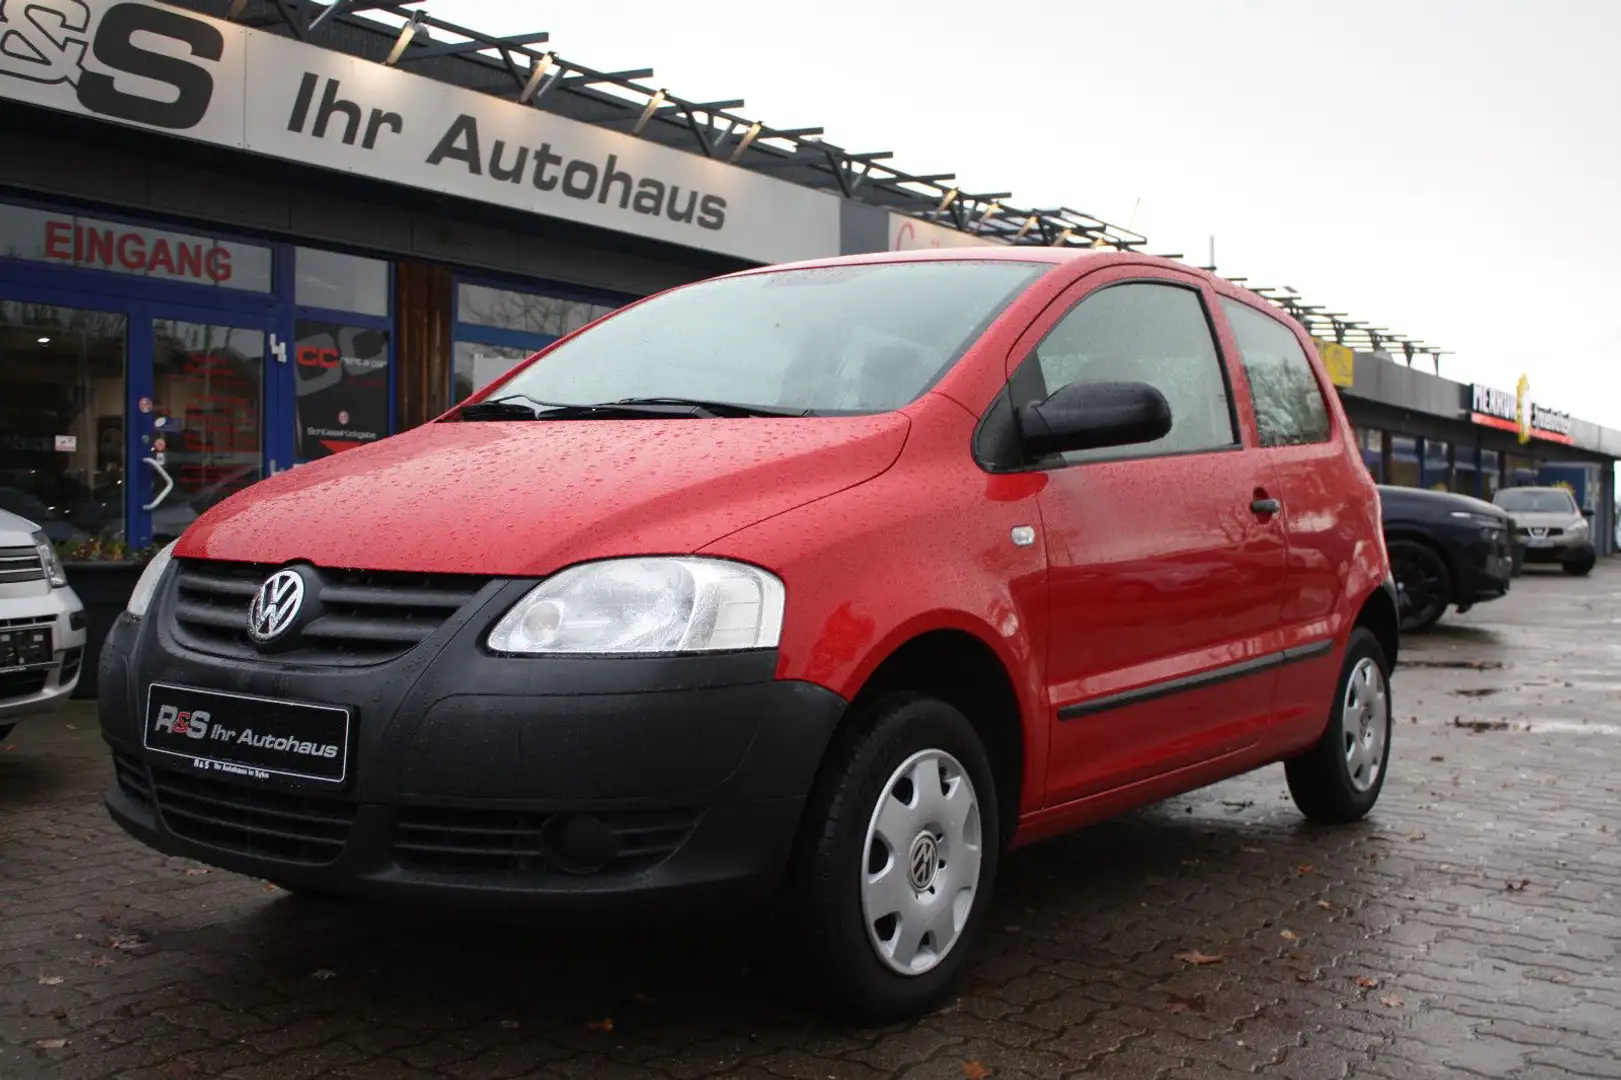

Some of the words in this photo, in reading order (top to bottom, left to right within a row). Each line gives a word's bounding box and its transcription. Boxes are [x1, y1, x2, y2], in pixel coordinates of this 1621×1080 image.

[287, 71, 403, 150] Ihr
[425, 113, 727, 231] Autohaus
[45, 220, 232, 283] EINGANG
[155, 704, 211, 739] R&S
[210, 723, 237, 742] Ihr
[236, 728, 339, 759] Autohaus
